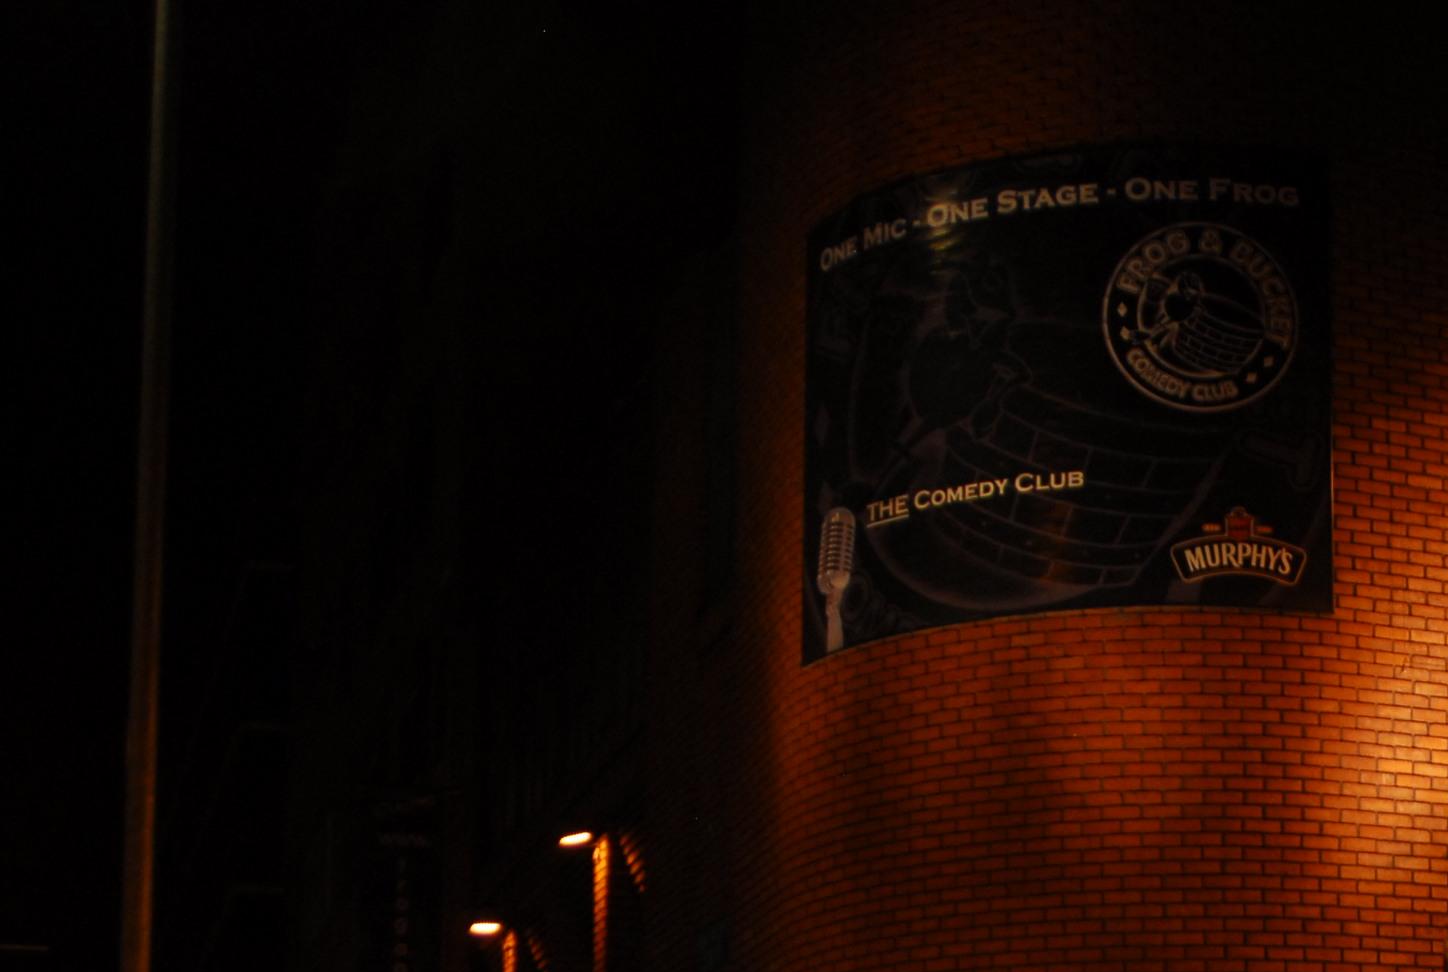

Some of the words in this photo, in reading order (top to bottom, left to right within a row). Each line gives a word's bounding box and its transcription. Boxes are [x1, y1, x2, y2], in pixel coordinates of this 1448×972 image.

[863, 217, 908, 249] MIC
[996, 180, 1100, 215] STAGE
[1208, 176, 1301, 207] FROG
[1116, 229, 1192, 295] FROG
[1228, 239, 1294, 350] BUCKET
[1192, 379, 1240, 401] CLUB
[866, 494, 909, 523] THE
[913, 476, 1010, 511] COMEDY
[1013, 470, 1086, 496] CLUB
